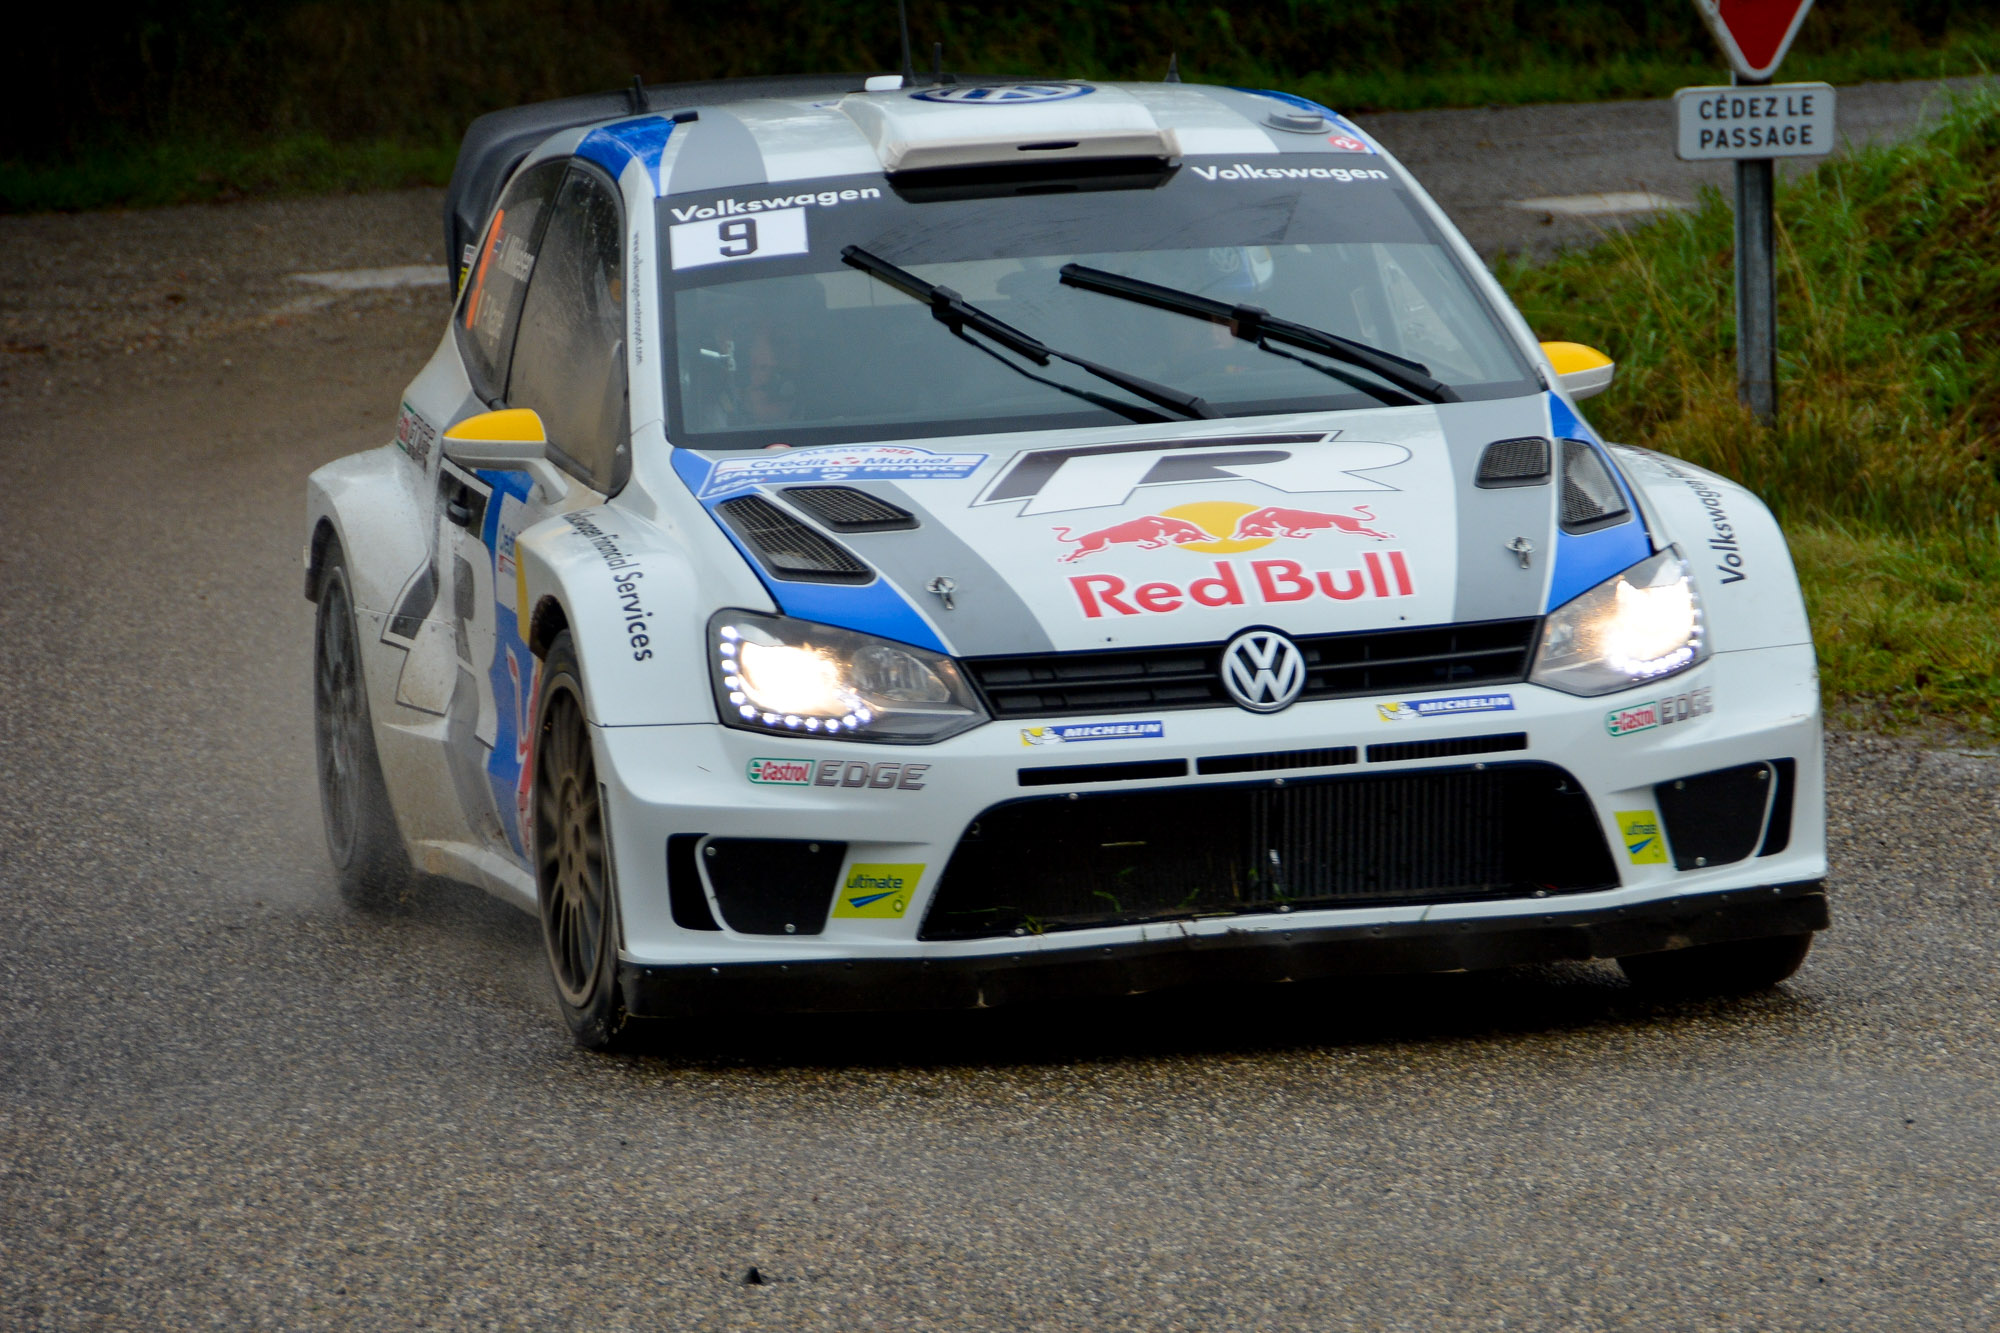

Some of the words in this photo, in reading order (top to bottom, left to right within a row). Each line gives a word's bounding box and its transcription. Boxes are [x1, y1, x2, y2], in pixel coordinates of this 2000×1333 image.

[1699, 94, 1778, 120] CÉDEZ
[1786, 95, 1814, 117] LE
[1699, 124, 1813, 149] PASSAGE
[1190, 163, 1390, 182] Volkswagen
[670, 187, 881, 222] Volkswagen
[718, 217, 758, 257] 9
[714, 468, 814, 484] RALLYE
[1685, 480, 1747, 584] Volkswagen
[1069, 561, 1245, 618] Red
[1250, 551, 1414, 604] Bull
[613, 571, 654, 662] Services
[1418, 697, 1510, 711] MICHELIN
[1063, 724, 1162, 737] MICHELIN
[1620, 705, 1657, 731] Castrol
[762, 761, 811, 781] Castrol
[814, 760, 932, 790] EDGE
[847, 874, 904, 888] ultimate
